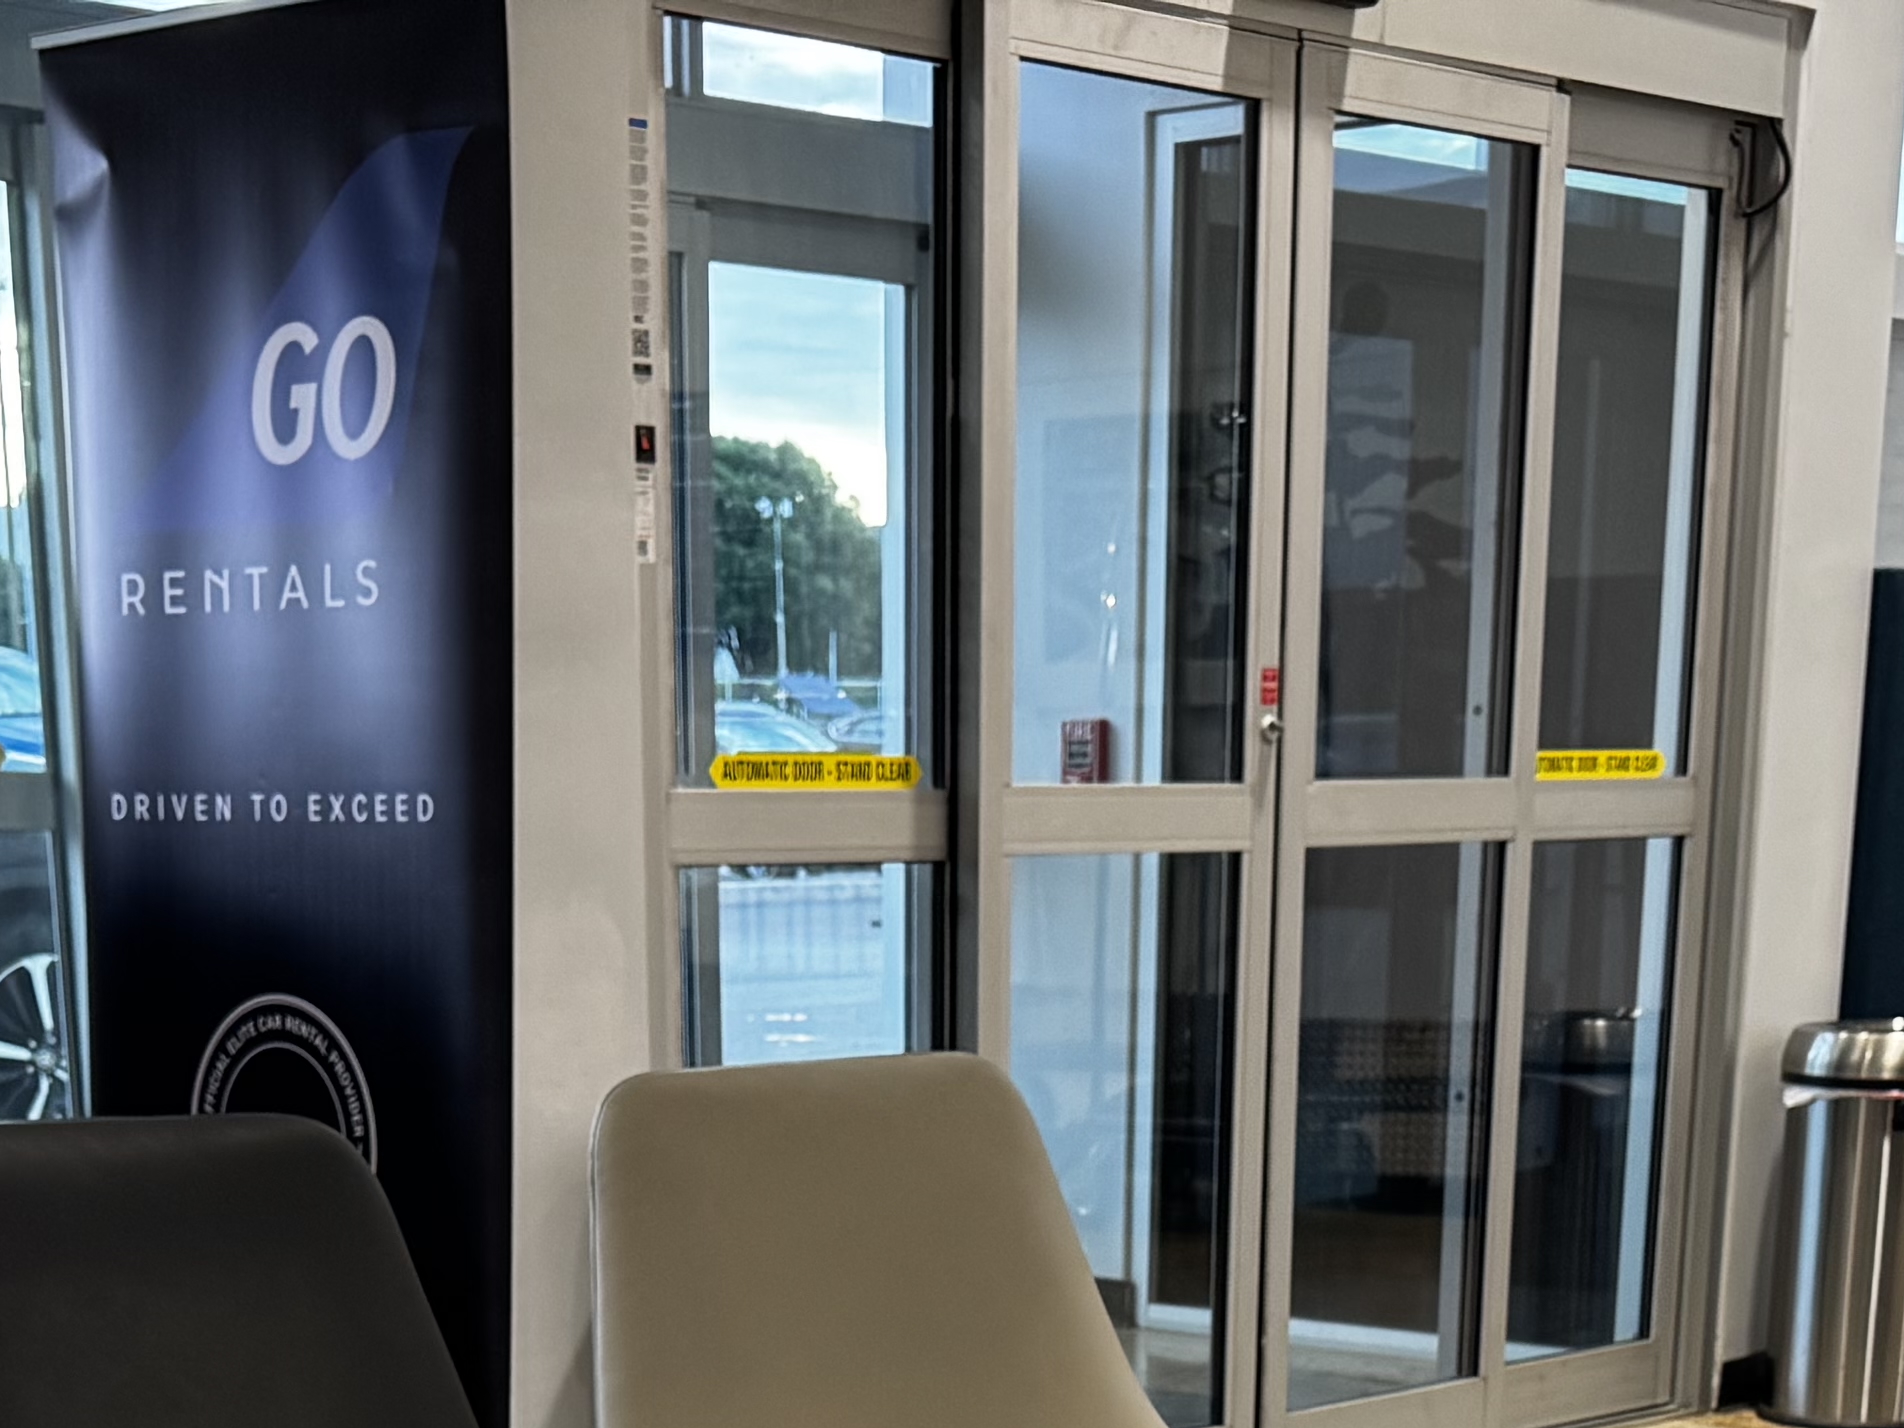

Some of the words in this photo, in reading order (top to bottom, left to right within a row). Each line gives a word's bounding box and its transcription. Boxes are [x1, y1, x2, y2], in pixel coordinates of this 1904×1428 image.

[251, 315, 397, 466] GO
[120, 558, 379, 616] RENTALS
[109, 791, 232, 822] DRIVEN
[250, 793, 288, 822] TO
[307, 793, 435, 823] EXCEED
[328, 1049, 365, 1138] PROVIDER
